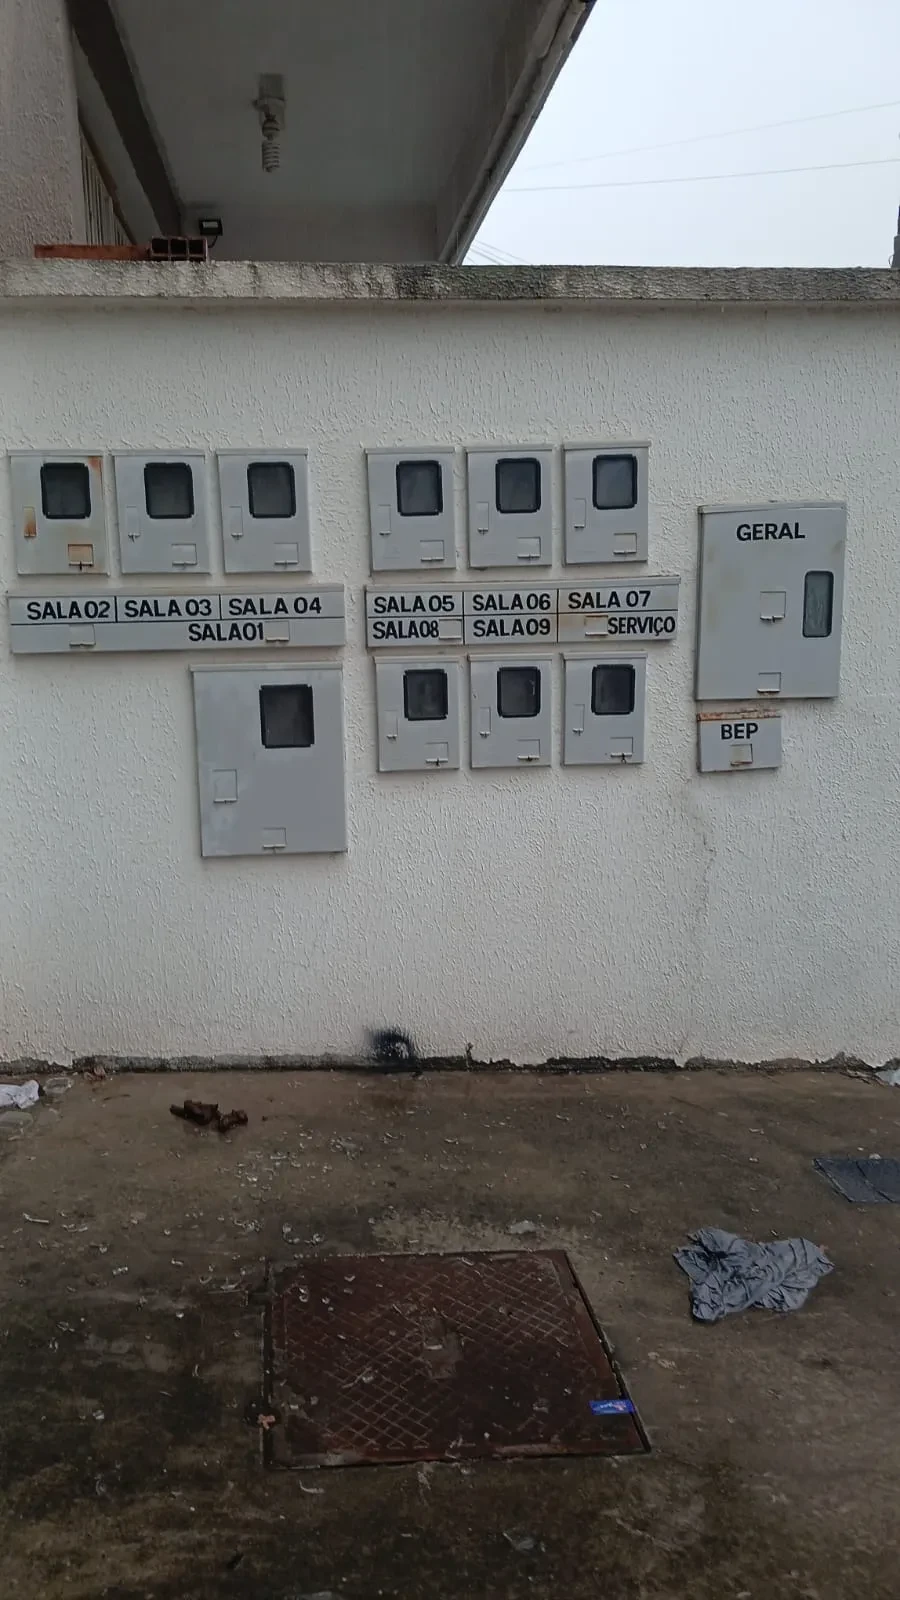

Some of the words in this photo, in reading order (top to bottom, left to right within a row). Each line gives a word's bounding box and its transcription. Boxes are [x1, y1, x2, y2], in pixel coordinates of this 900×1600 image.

[736, 522, 806, 541] GERAL
[228, 597, 289, 616] SALA
[293, 597, 322, 614] 04
[567, 591, 622, 610] SALA
[625, 590, 651, 607] 07
[607, 616, 676, 637] SERVIÇO
[720, 722, 759, 741] BEP
